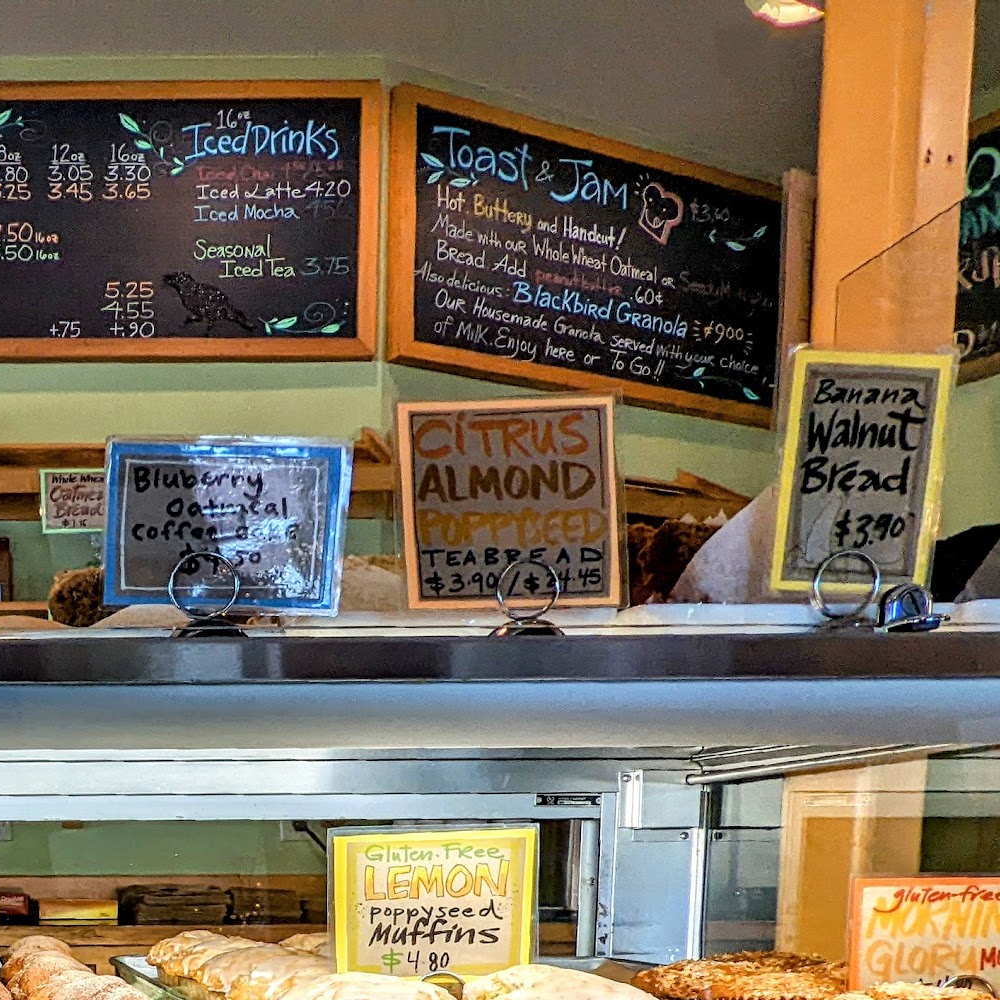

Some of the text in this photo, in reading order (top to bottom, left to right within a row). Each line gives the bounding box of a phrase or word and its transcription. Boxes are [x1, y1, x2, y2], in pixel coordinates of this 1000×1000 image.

[432, 126, 533, 191] Toast
[535, 161, 555, 182] &
[48, 165, 93, 182] 3.05
[104, 165, 150, 182] 3.30
[48, 182, 93, 201] 3.45
[102, 182, 150, 200] 3.65
[196, 184, 239, 200] Iced
[193, 204, 239, 222] Iced
[243, 203, 301, 220] Mocha
[537, 216, 558, 234] and
[431, 213, 474, 242] Made
[477, 230, 502, 249] with
[532, 234, 570, 265] Whole
[610, 255, 657, 284] Oatmeal
[218, 260, 263, 279] Iced
[491, 254, 528, 279] Add
[104, 282, 155, 299] 5.25
[101, 300, 155, 320] 4.55
[433, 315, 454, 337] of
[493, 326, 538, 362] Enjoy
[812, 379, 927, 410] Banana
[807, 407, 927, 454] Walnut
[417, 460, 597, 502] ALMOND
[800, 456, 911, 495] Bread
[364, 859, 511, 901] LEMON
